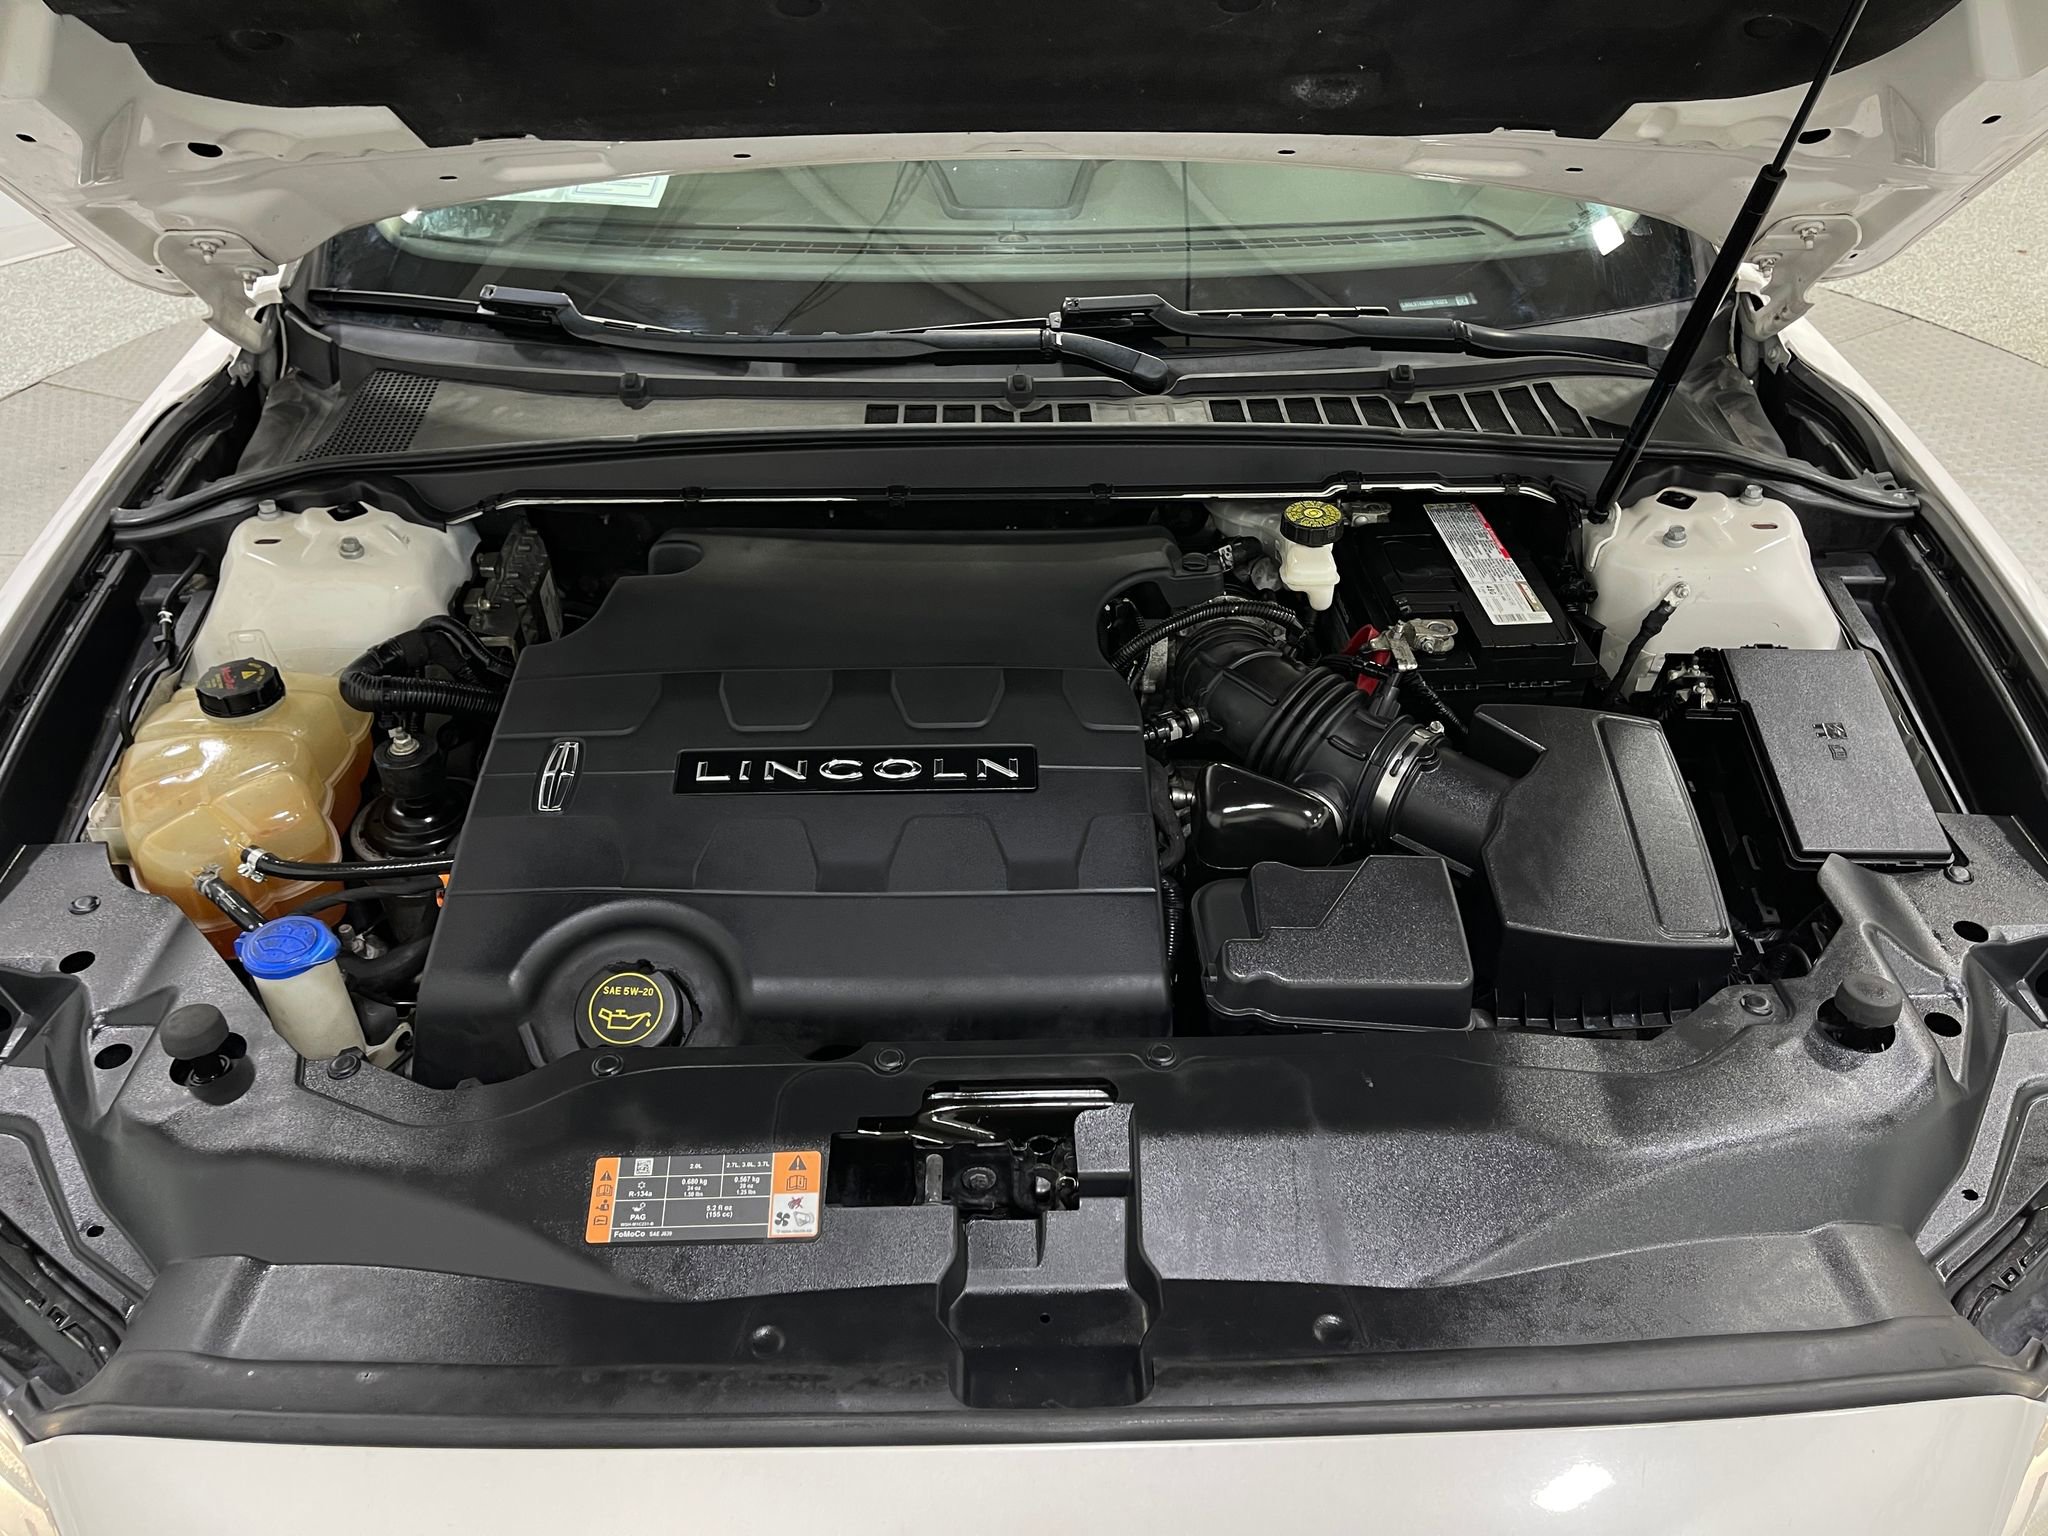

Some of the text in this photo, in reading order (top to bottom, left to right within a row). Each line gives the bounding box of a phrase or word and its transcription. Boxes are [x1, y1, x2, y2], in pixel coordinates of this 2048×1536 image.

[696, 758, 1019, 781] LINCOLN
[603, 986, 654, 997] SAE 5W-20
[699, 1178, 708, 1186] kg
[752, 1176, 760, 1184] kg
[630, 1213, 646, 1221] PAG
[705, 1211, 721, 1219] (155
[614, 1230, 645, 1238] FoMoCo
